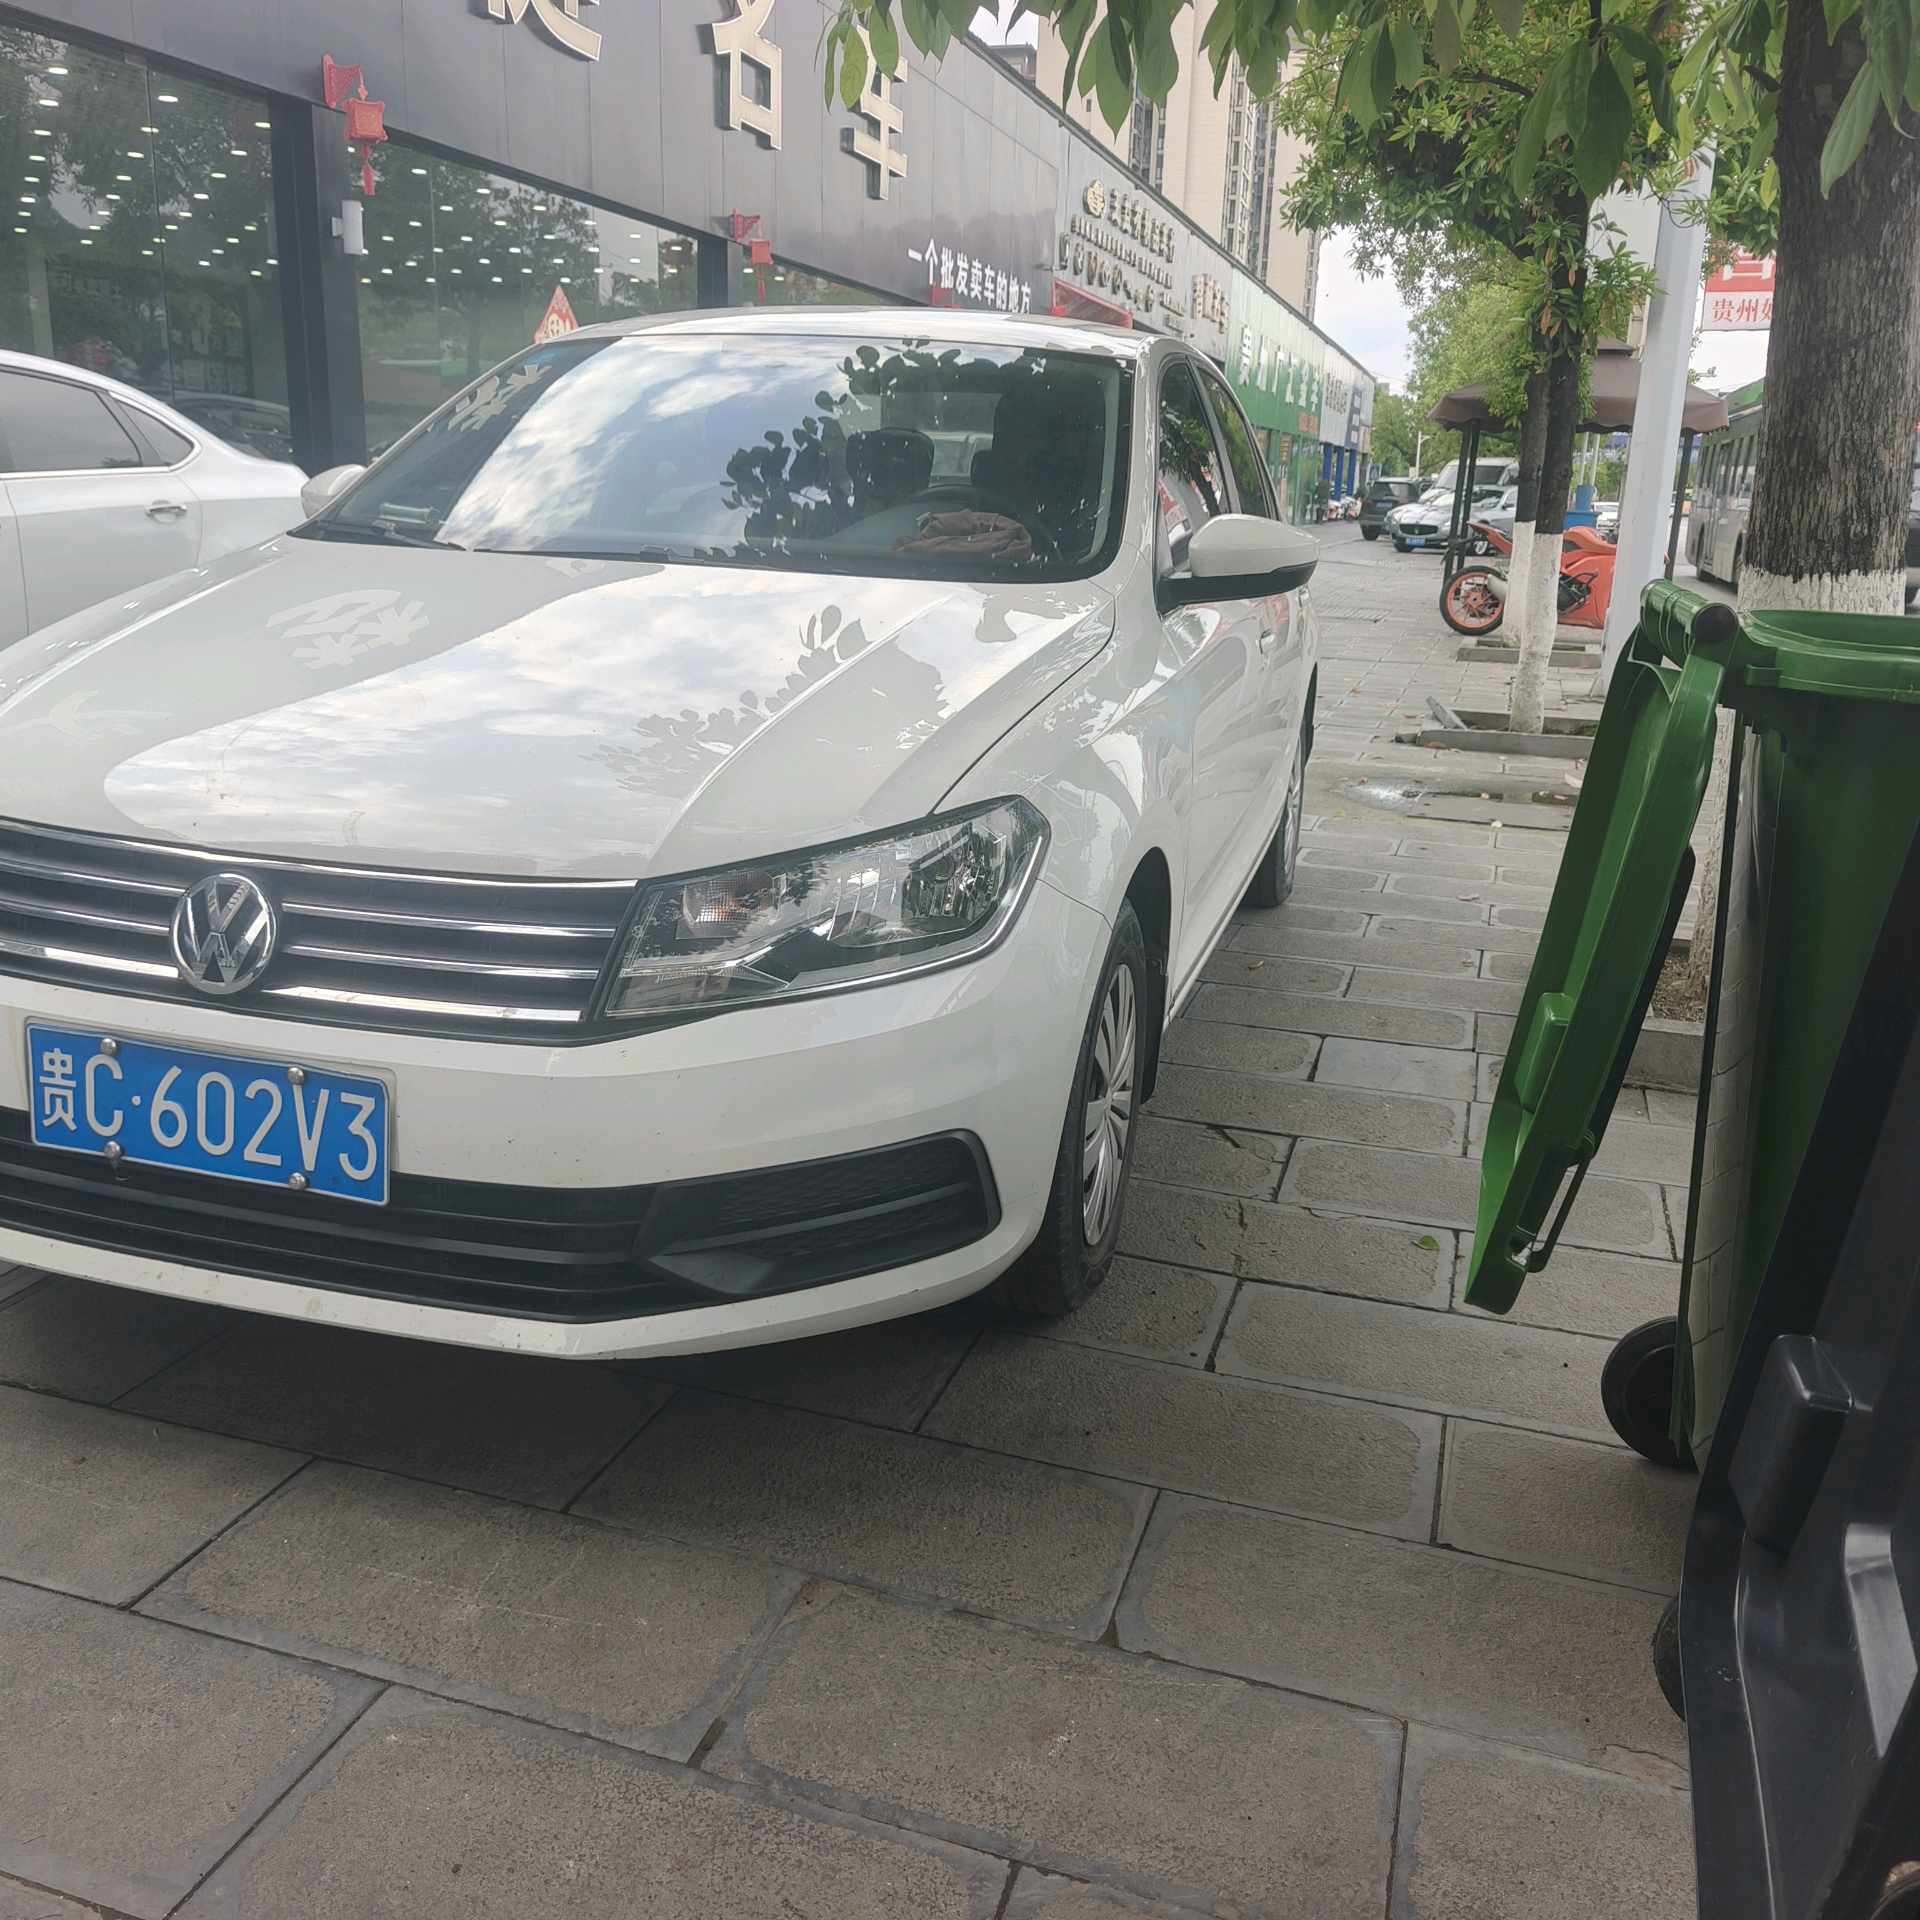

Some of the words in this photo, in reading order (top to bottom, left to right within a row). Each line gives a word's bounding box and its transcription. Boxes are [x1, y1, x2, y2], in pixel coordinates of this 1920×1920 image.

[908, 238, 1031, 313] 一个批发卖车的地方
[39, 1047, 378, 1182] 贵C·602V3
